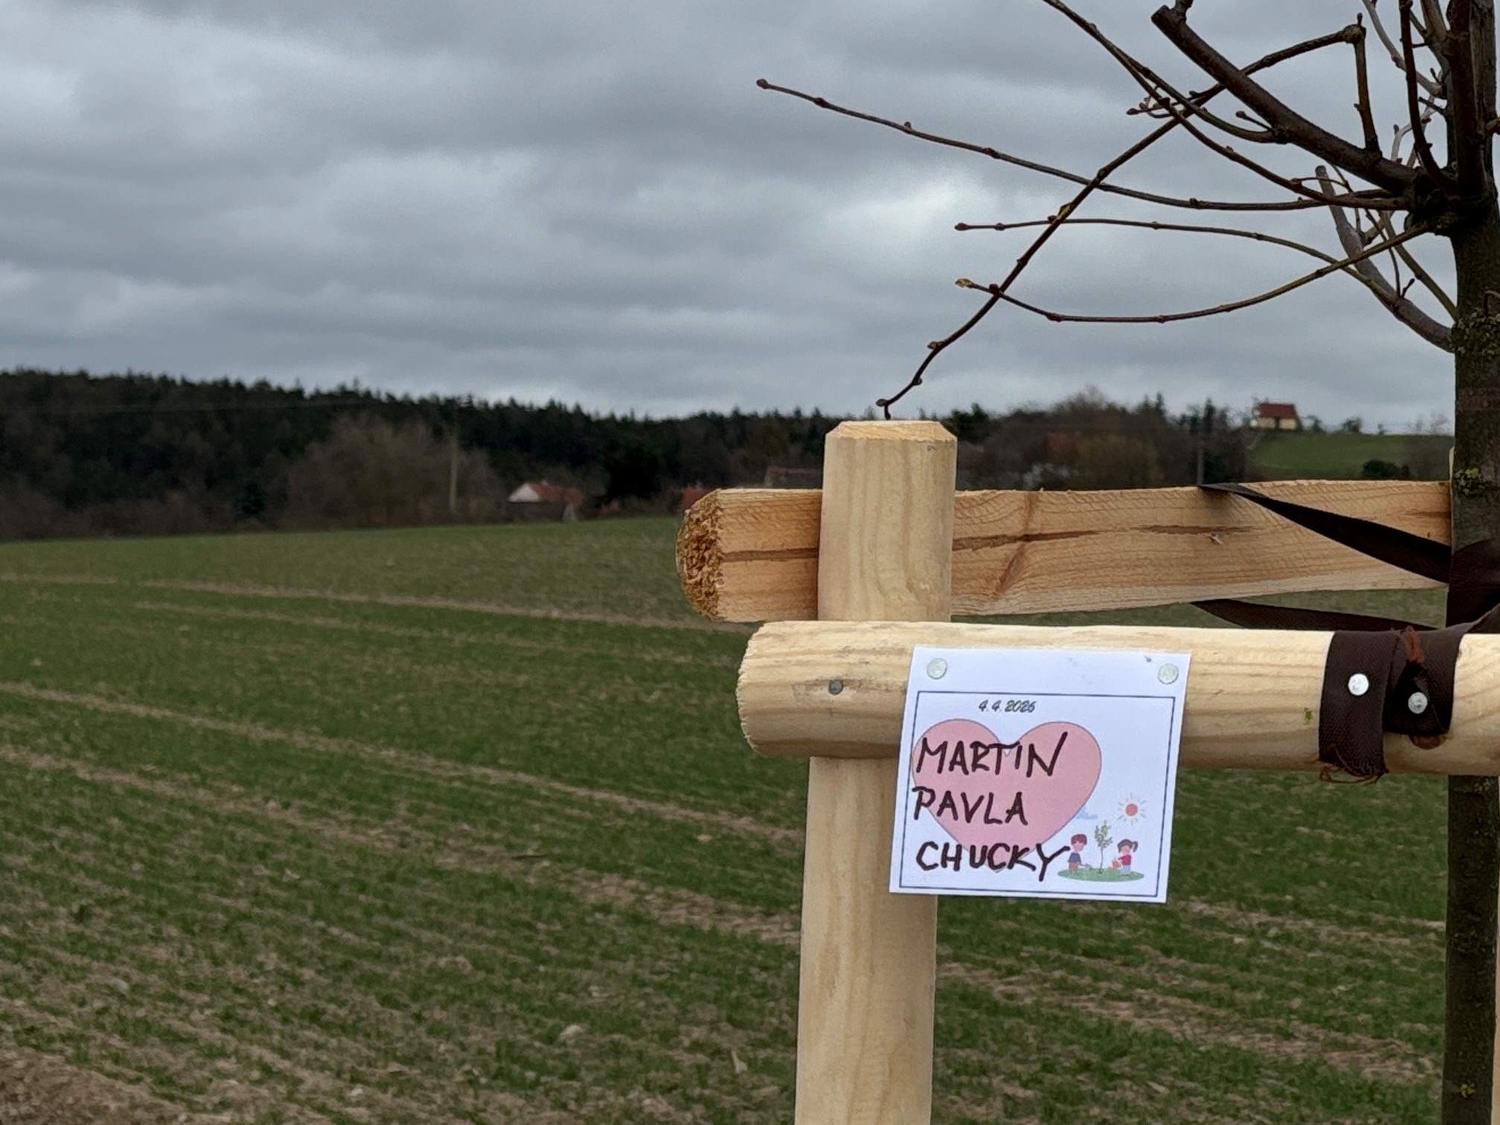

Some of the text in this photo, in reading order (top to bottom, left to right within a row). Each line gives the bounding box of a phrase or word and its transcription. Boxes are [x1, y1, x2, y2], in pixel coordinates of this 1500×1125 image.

[915, 731, 1068, 778] MARTIN
[912, 785, 1029, 826] PAVLA
[915, 840, 1071, 882] CHUCKY
